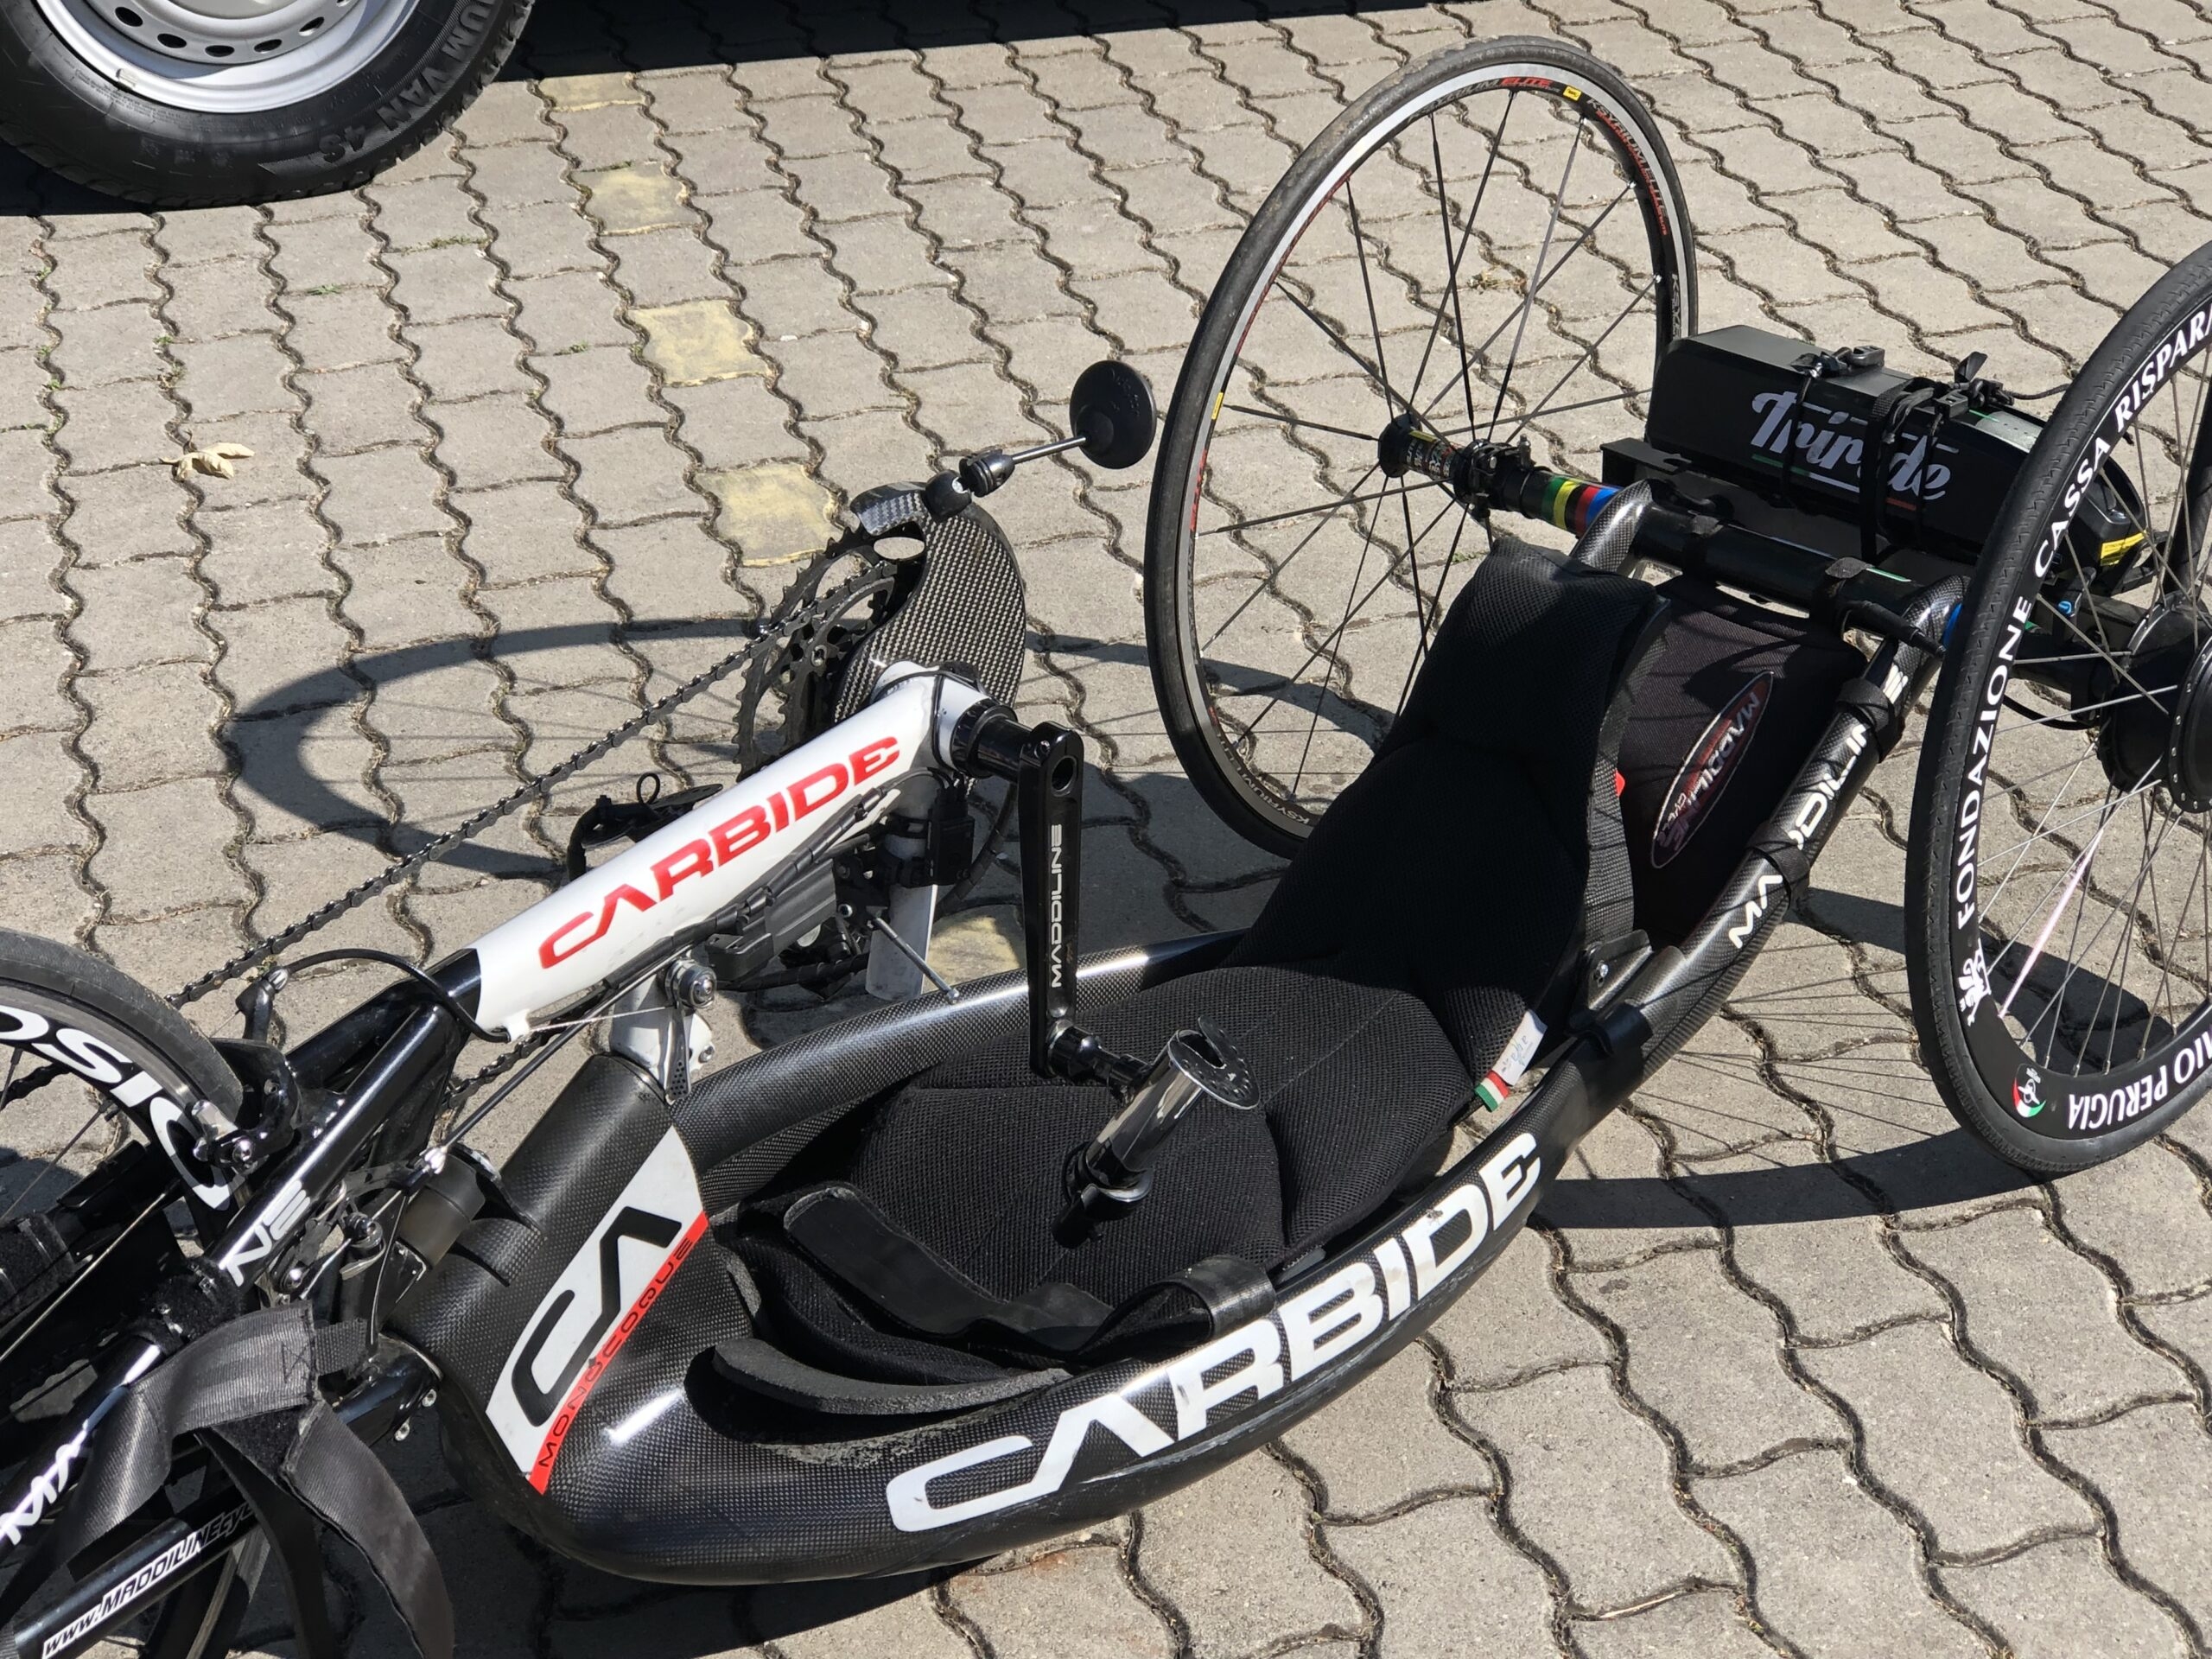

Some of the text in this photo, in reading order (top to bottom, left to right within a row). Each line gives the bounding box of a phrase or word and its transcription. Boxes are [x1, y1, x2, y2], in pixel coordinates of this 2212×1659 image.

[376, 67, 450, 131] VAN
[1500, 76, 1553, 87] ELITE
[1956, 595, 2031, 931] FONDAZIONE
[2034, 436, 2111, 578] CASSA
[537, 735, 900, 970] CARBIDE
[1051, 823, 1063, 988] MADDILINE
[2068, 1065, 2169, 1130] PERUGIA
[537, 1236, 692, 1468] MONOCOQUE
[885, 1131, 1542, 1533] CARBIDE
